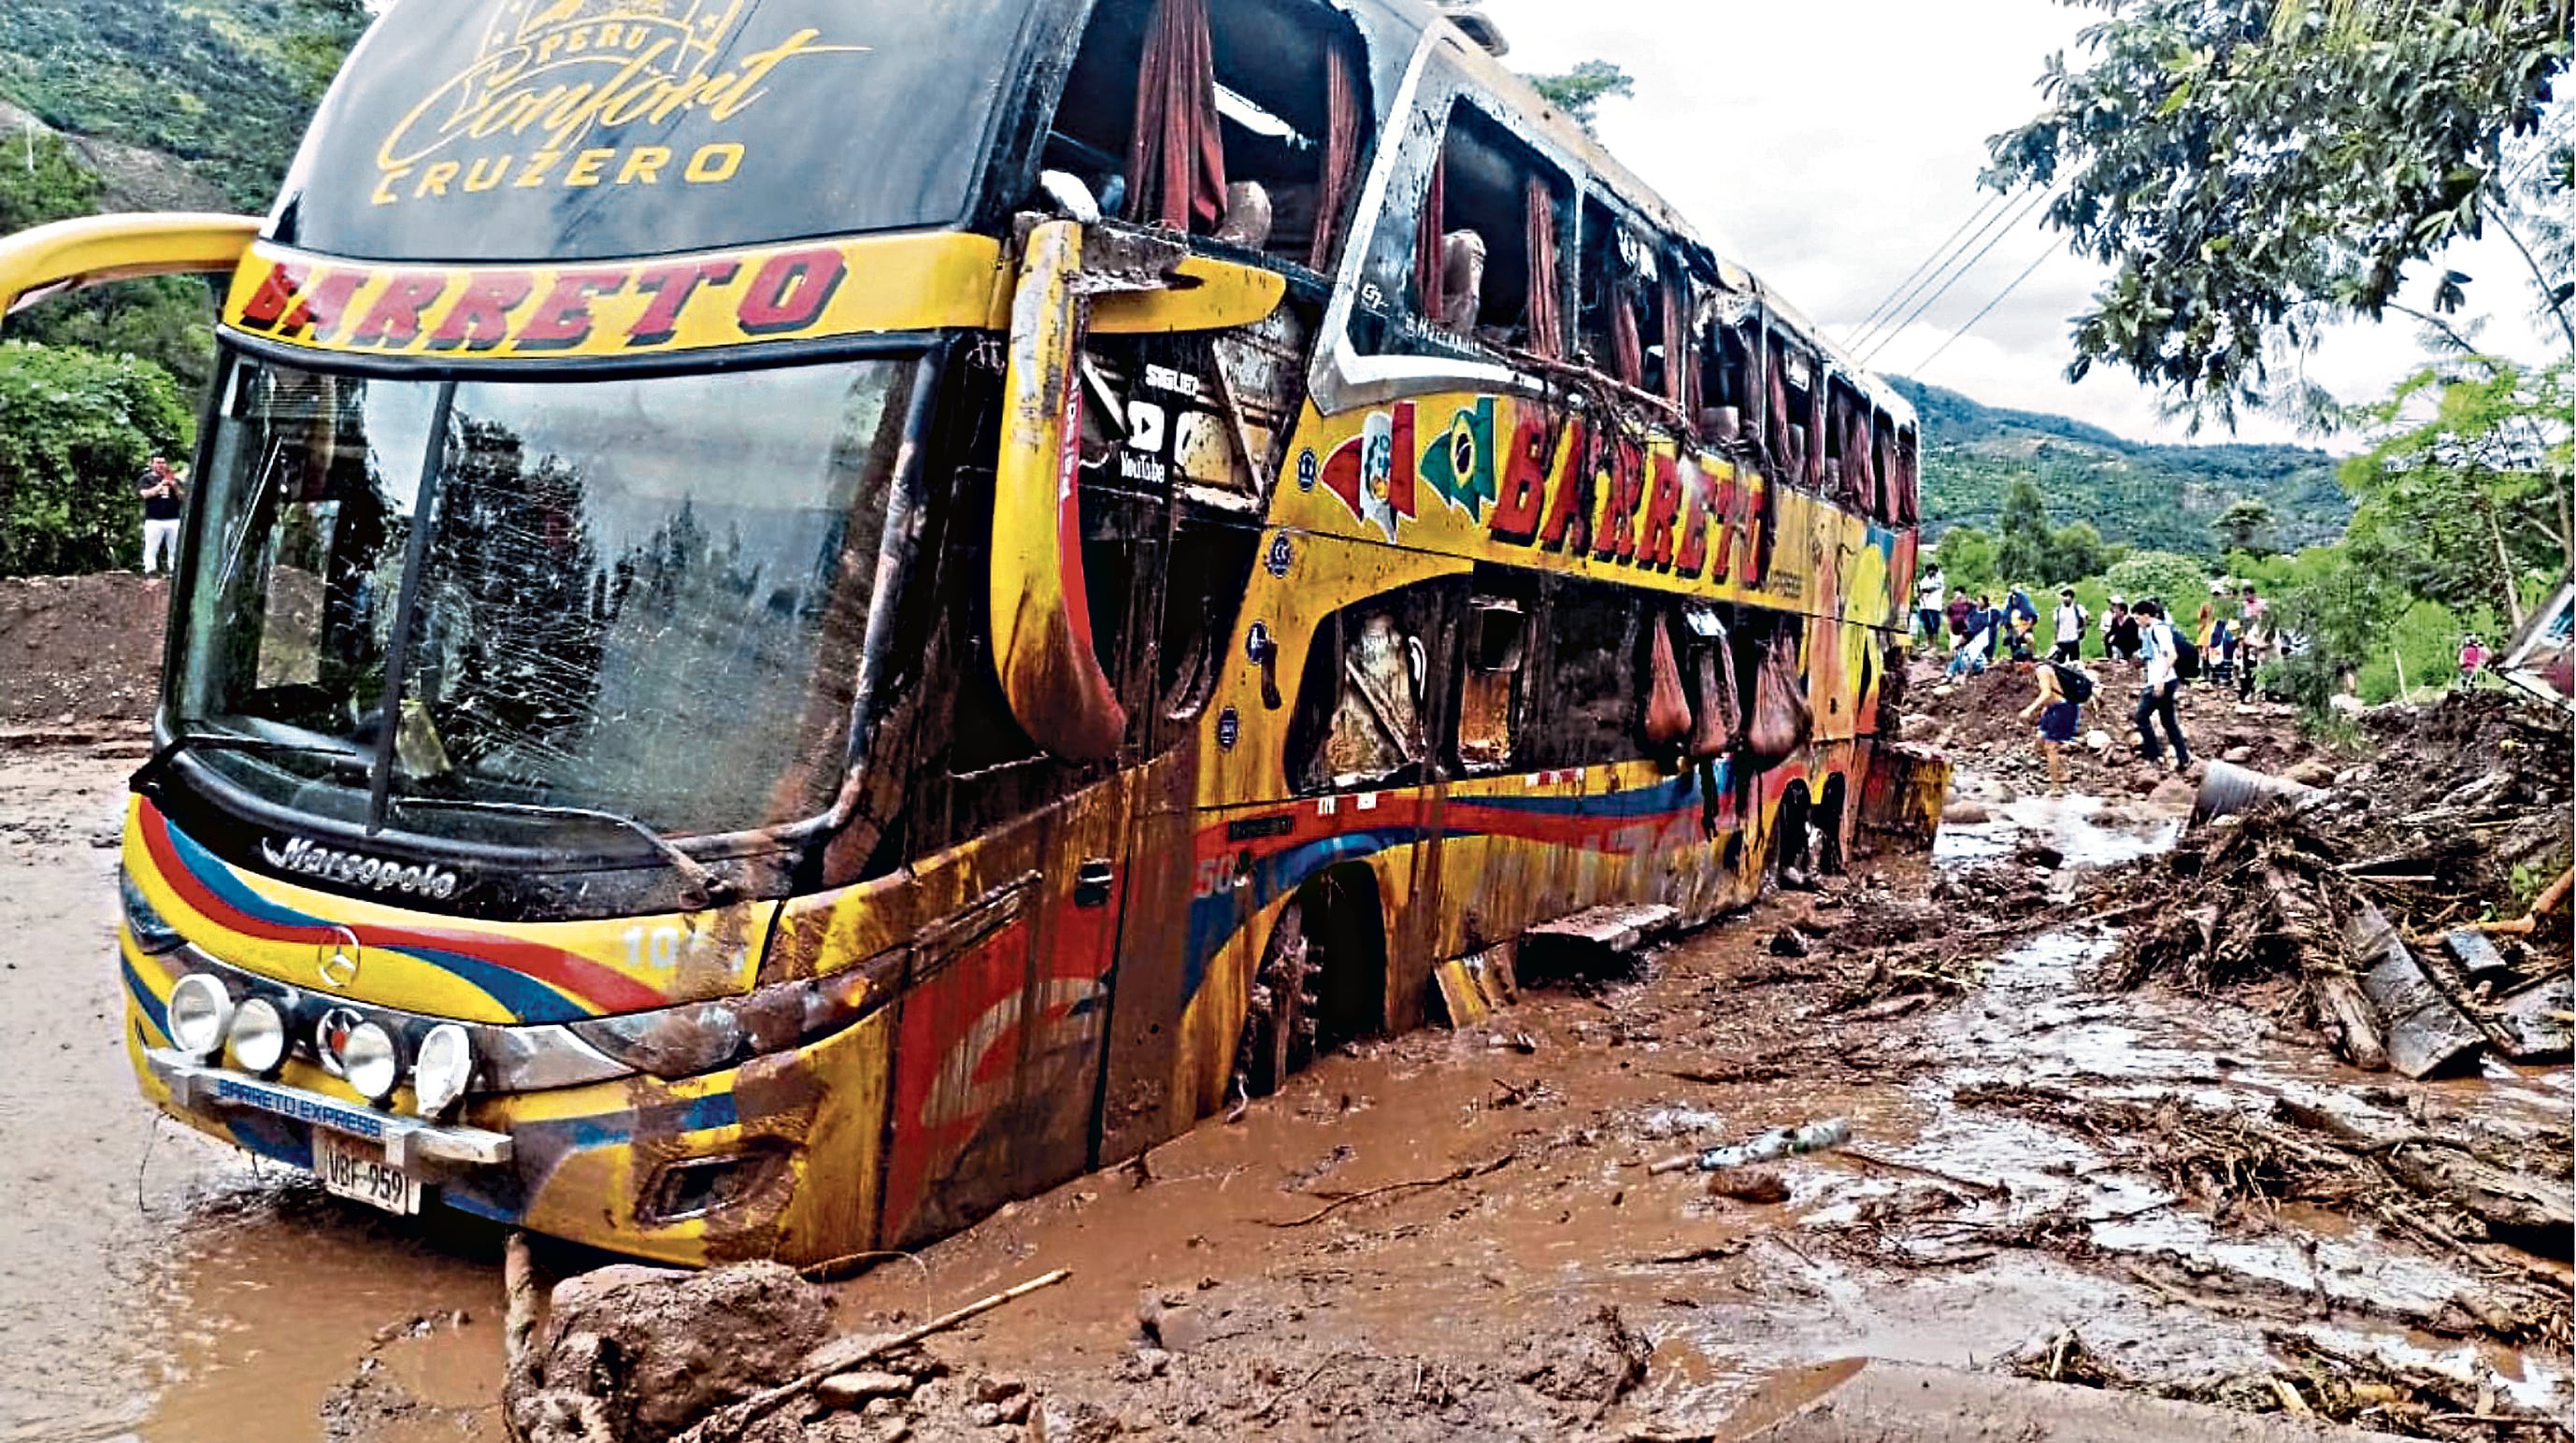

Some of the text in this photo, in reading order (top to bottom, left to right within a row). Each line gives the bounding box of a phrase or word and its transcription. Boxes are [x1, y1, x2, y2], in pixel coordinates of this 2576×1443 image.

[536, 22, 651, 64] PERU
[372, 141, 747, 206] CRUZERO
[236, 248, 849, 351] BARRETO
[1120, 450, 1166, 483] YouTube
[262, 836, 457, 900] Marcopolo
[218, 1078, 381, 1137] BARRETO EXPRESS
